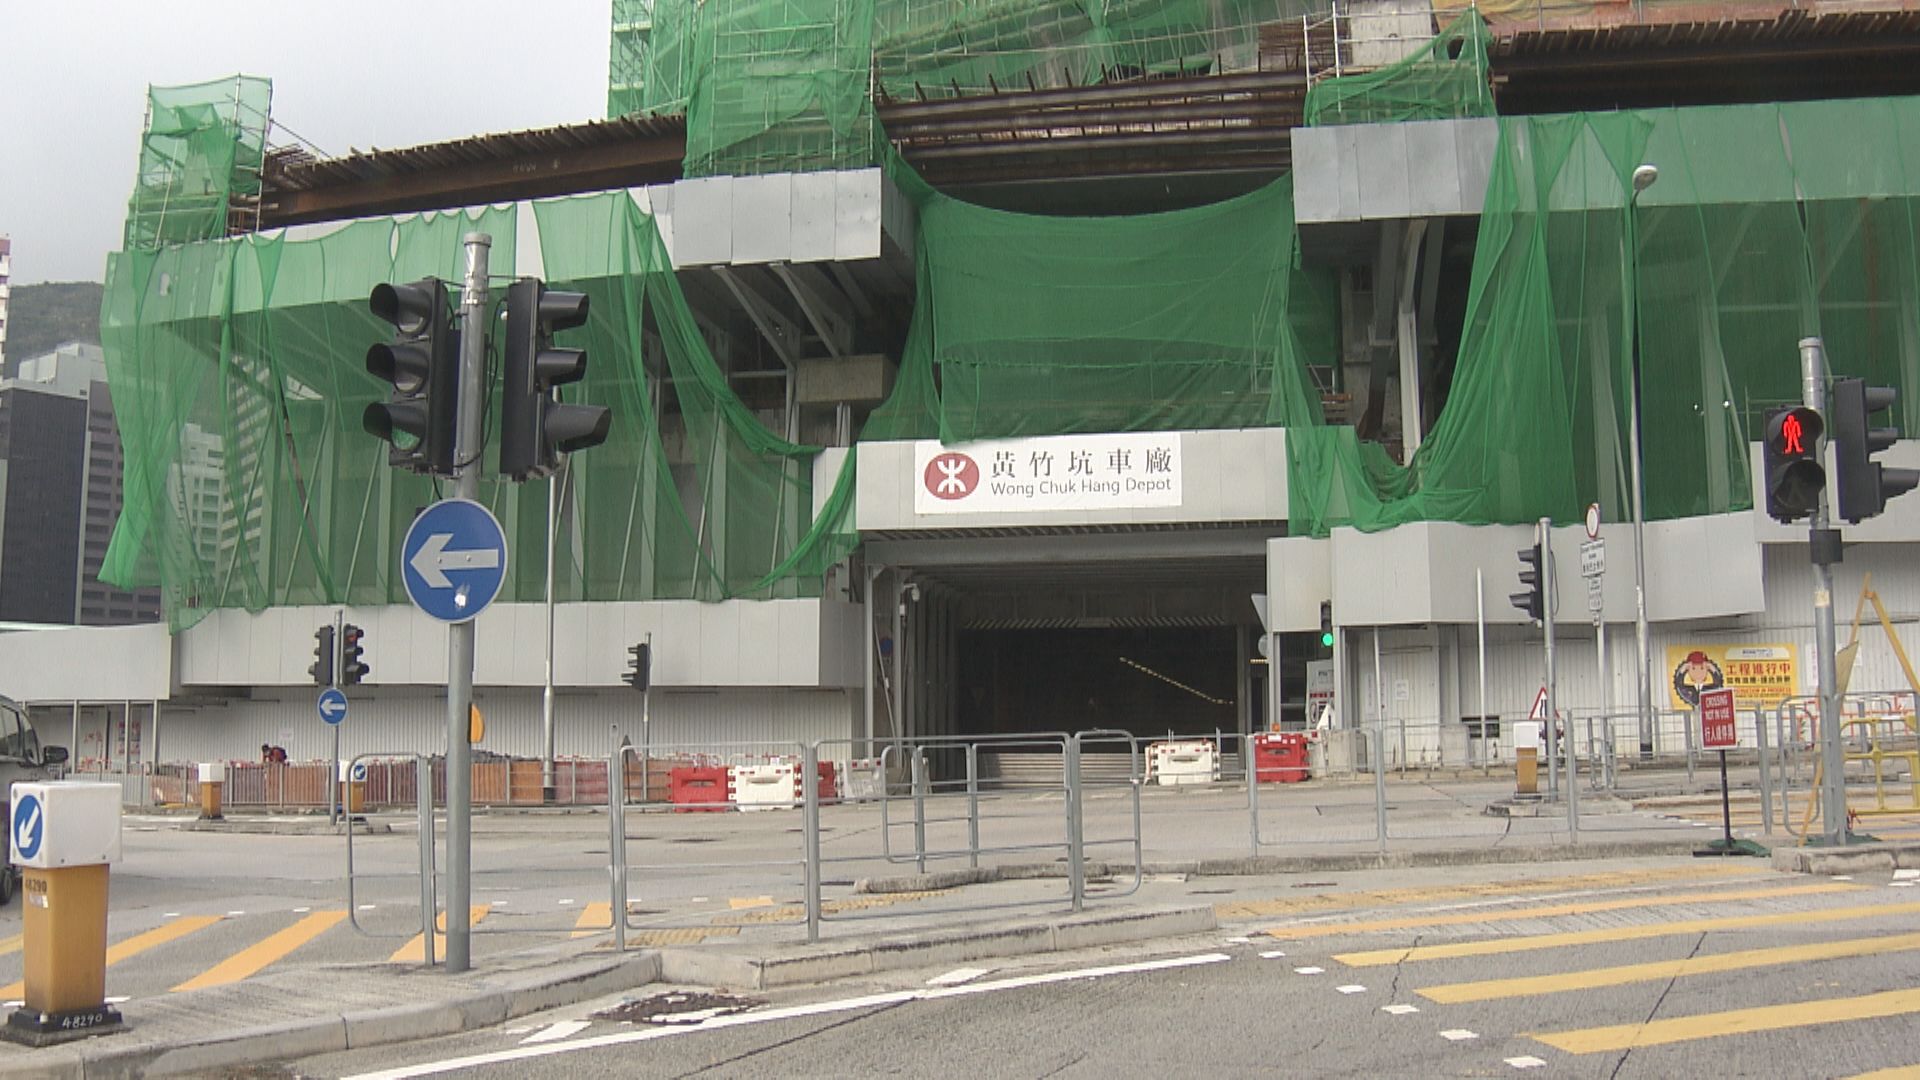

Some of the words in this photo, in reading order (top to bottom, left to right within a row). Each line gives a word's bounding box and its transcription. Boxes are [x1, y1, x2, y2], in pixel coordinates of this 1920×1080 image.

[991, 447, 1172, 478] 黃竹坑車廠
[991, 480, 1035, 498] Wong
[1038, 479, 1077, 494] Chuk
[1081, 478, 1121, 495] Hang
[1125, 476, 1172, 493] Depot
[1726, 663, 1790, 675] 工程進行中
[1705, 695, 1728, 708] CROSSING
[62, 1013, 103, 1029] 48290
